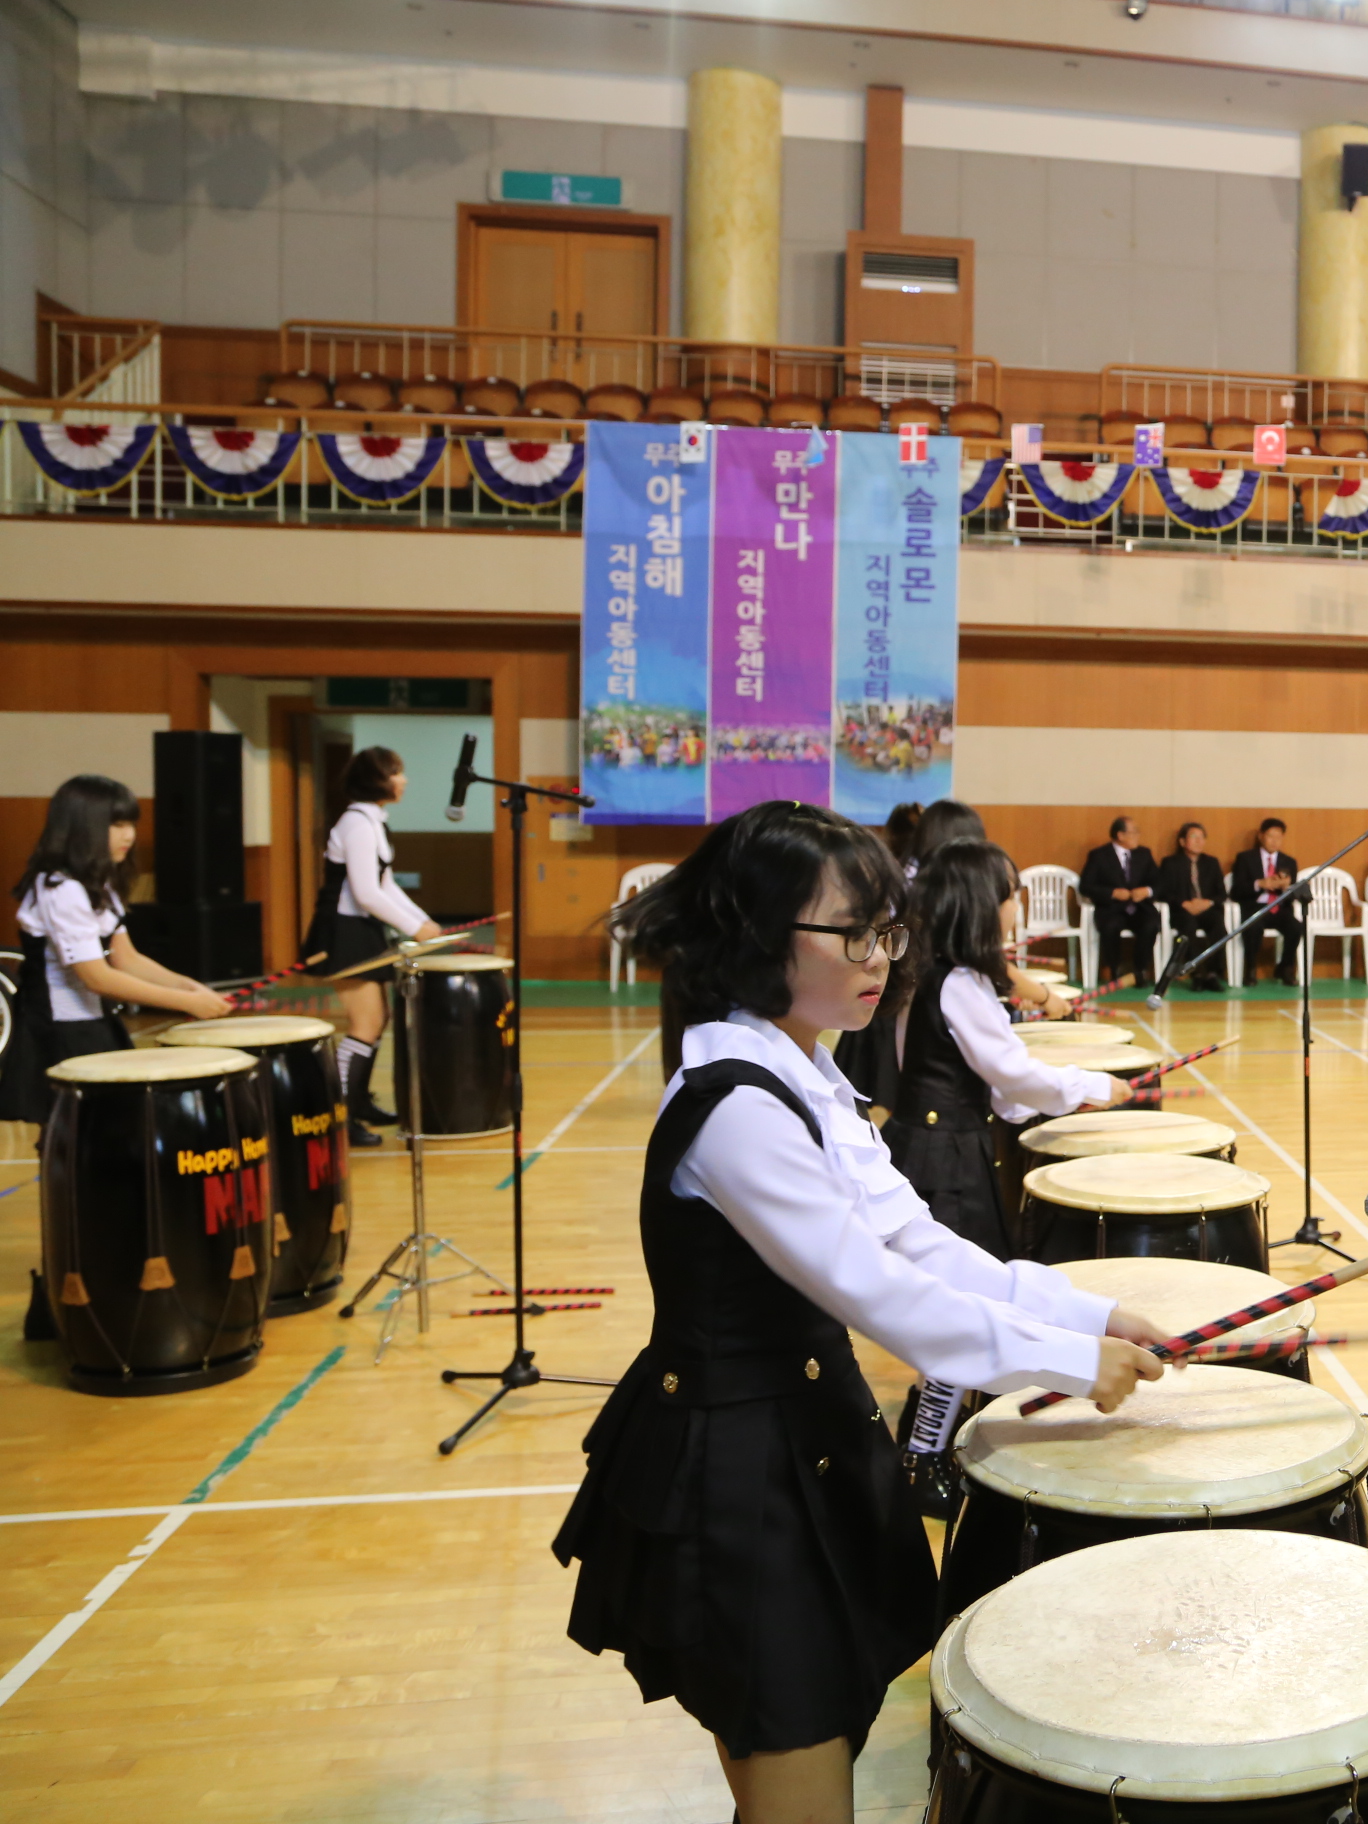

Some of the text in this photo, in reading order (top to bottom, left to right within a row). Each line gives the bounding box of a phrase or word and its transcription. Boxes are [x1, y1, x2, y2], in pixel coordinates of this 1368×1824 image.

[644, 474, 687, 597] 아침해
[774, 481, 814, 561] 만나
[899, 487, 938, 603] 솔로몬
[606, 543, 638, 701] 지역아동센터
[735, 549, 767, 702] 지역아동센터
[864, 554, 892, 703] 지역아동센터
[177, 1148, 240, 1175] Happy
